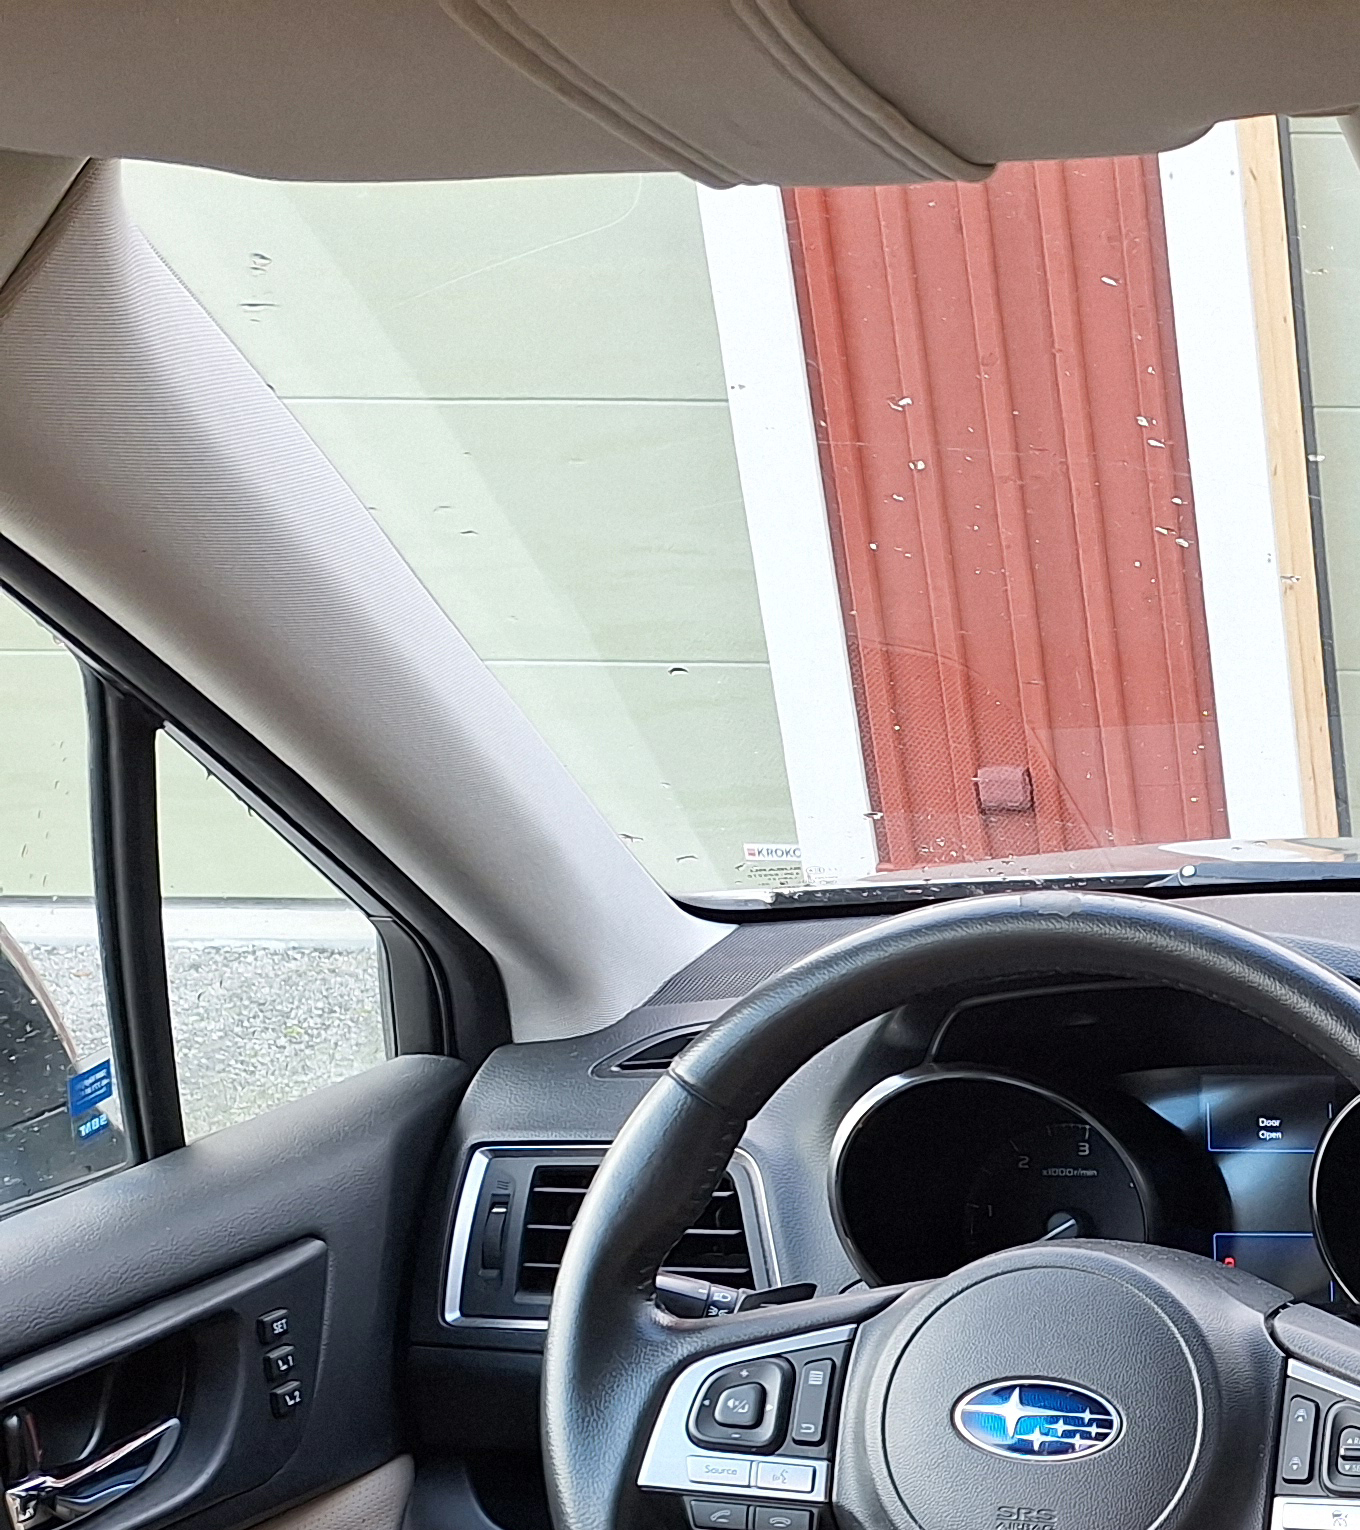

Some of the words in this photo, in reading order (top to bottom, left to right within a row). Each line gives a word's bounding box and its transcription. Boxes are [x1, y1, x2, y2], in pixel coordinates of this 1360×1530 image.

[1258, 1117, 1281, 1127] Door
[1258, 1130, 1282, 1141] Open
[1077, 1142, 1090, 1156] 3
[1018, 1155, 1030, 1169] 2
[272, 1318, 287, 1334] SET
[704, 1464, 738, 1476] Source
[996, 1505, 1057, 1522] SRS
